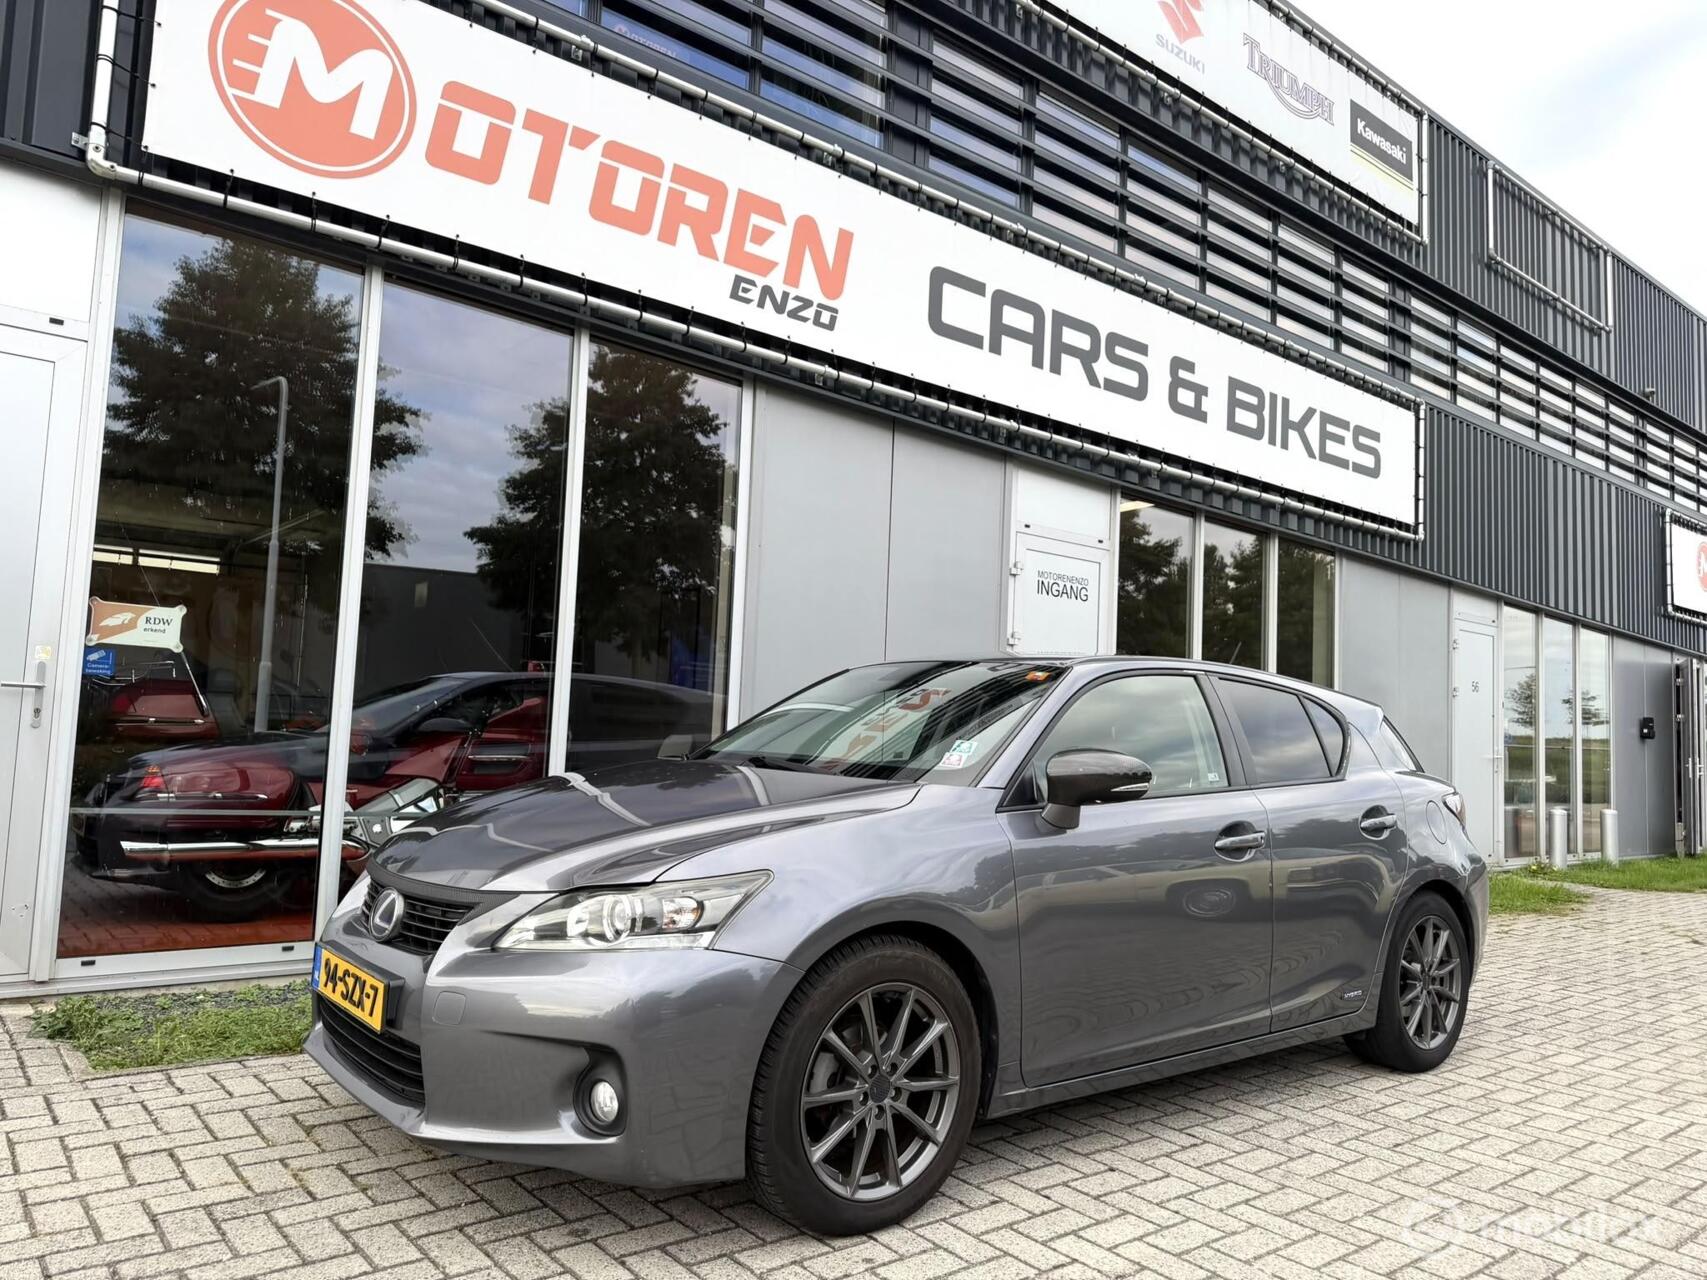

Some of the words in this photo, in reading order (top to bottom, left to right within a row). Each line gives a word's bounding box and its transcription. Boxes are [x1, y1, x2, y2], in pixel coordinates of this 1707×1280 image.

[1155, 33, 1206, 75] SUZUKI
[1243, 33, 1335, 126] TRIUMPH
[1356, 118, 1407, 165] Kawasaki
[730, 275, 838, 332] ENZO
[929, 267, 1149, 402] CARS
[1169, 356, 1208, 423] &
[1227, 377, 1381, 479] BIKES
[1037, 570, 1089, 586] MOTORENENZO
[1037, 580, 1089, 602] INGANG
[143, 626, 167, 634] erkend
[144, 616, 173, 626] RDW
[1471, 681, 1480, 693] 56
[323, 957, 379, 1018] 94-SZX-7
